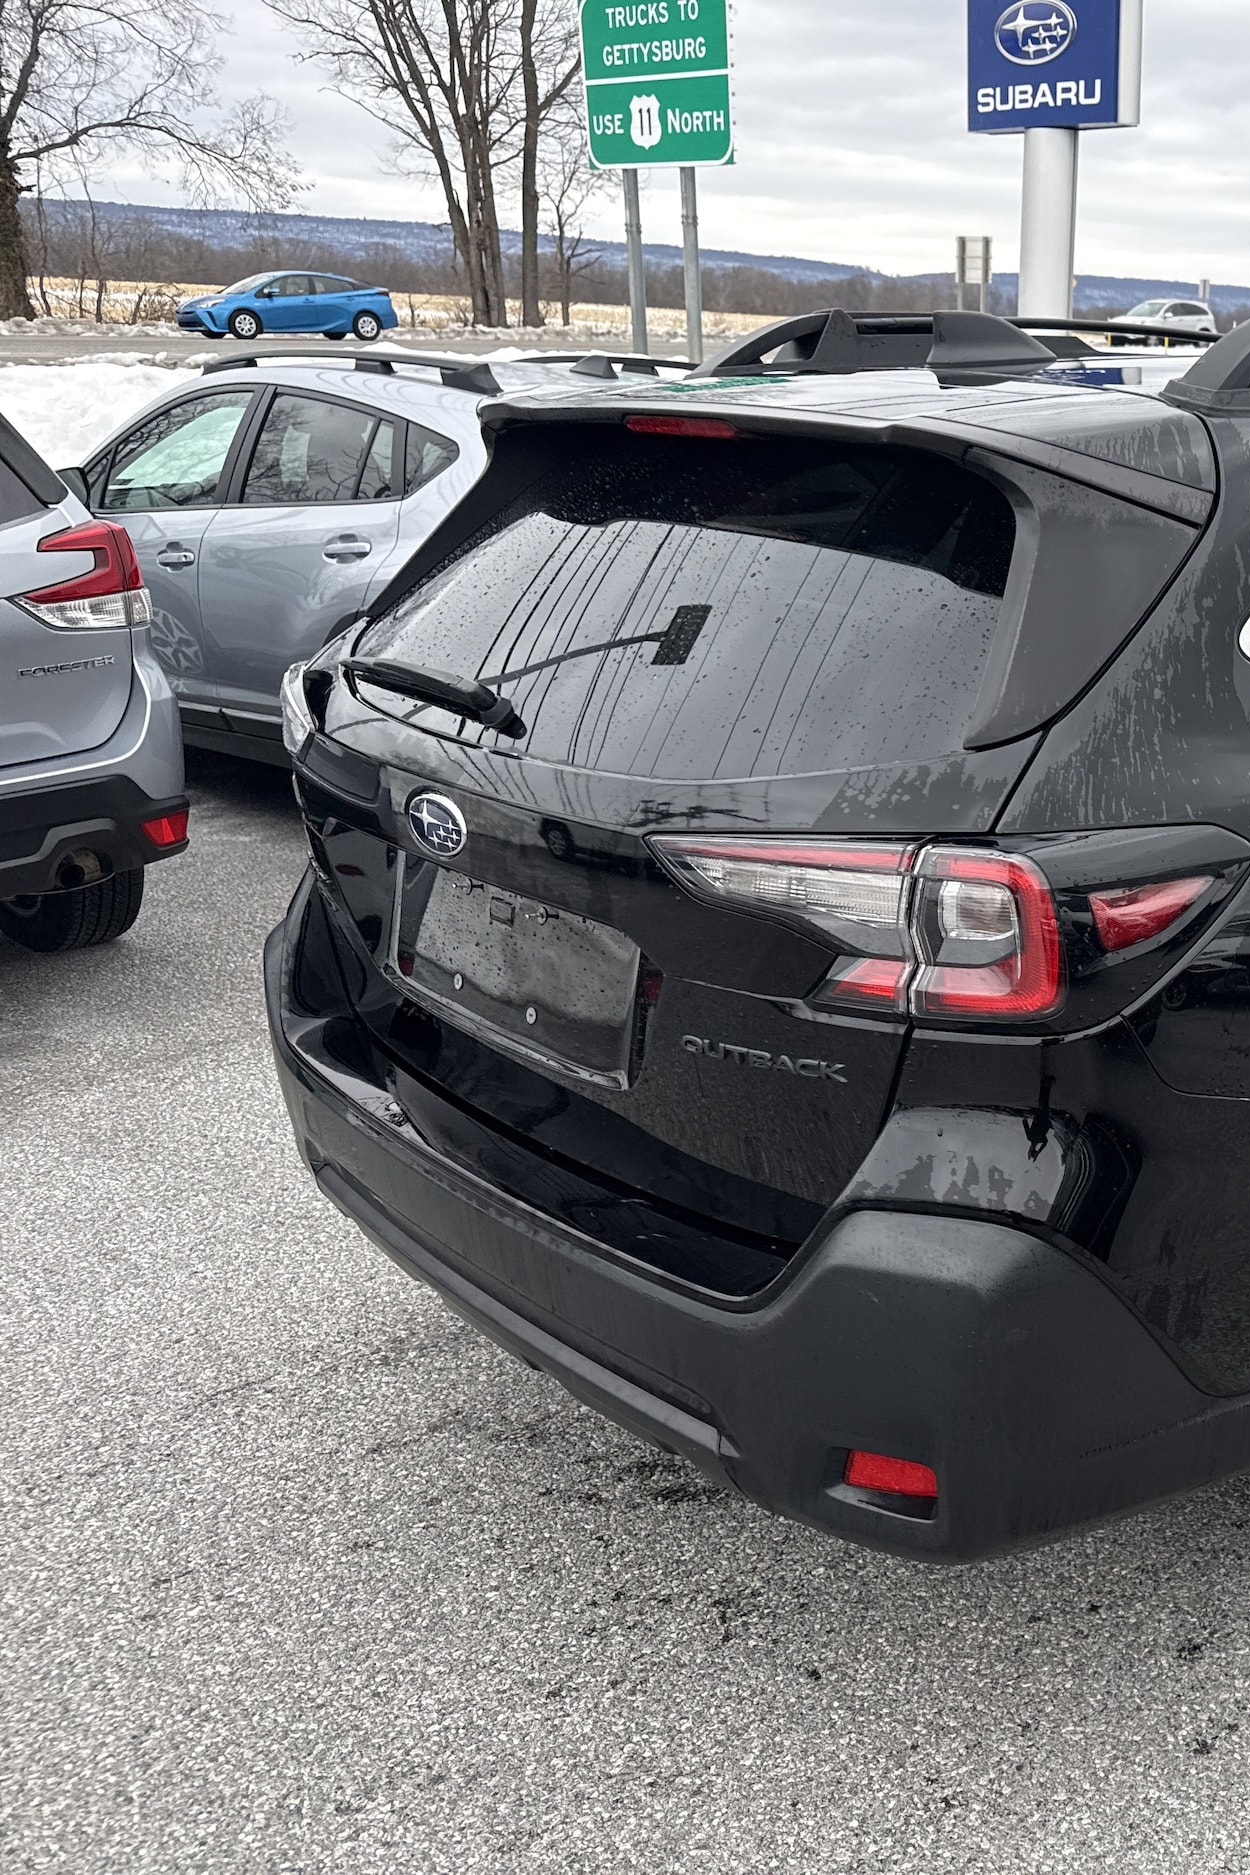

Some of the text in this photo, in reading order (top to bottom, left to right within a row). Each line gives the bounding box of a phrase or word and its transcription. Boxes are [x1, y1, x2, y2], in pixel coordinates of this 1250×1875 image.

[605, 0, 699, 28] TRUCKS TO
[602, 37, 706, 66] GETTYSBURG
[976, 79, 1101, 113] SUBARU
[593, 107, 725, 136] USE 11 NORTH
[18, 654, 115, 678] FORESTER
[681, 1034, 848, 1083] OUTBACK
